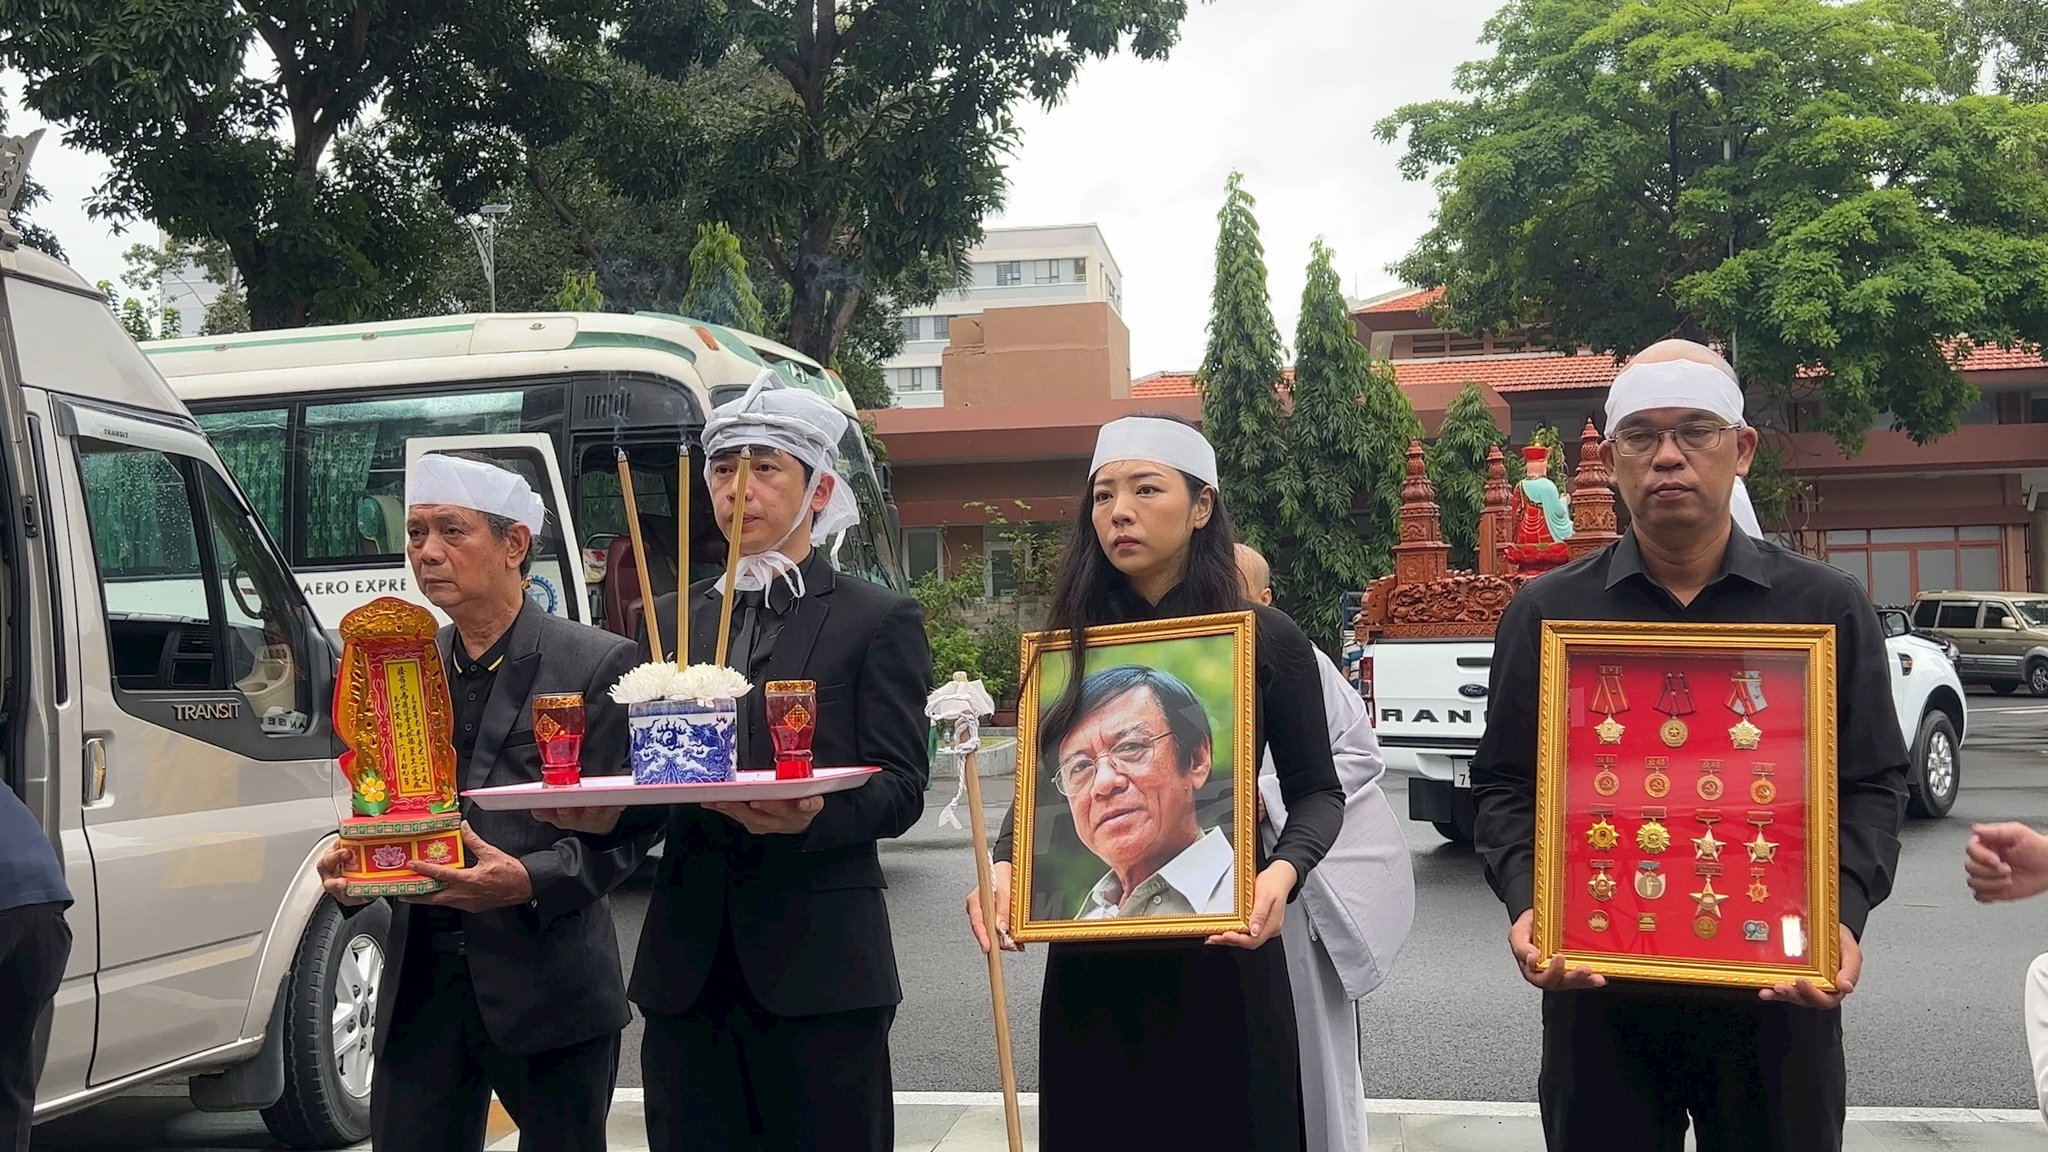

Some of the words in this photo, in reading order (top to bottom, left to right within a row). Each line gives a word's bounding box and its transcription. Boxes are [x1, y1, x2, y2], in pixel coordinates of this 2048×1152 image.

[104, 428, 129, 439] TRANSIT
[303, 580, 349, 595] AERO
[1464, 685, 1484, 695] Ford
[173, 703, 241, 720] TRANSIT
[1381, 708, 1488, 723] RAN
